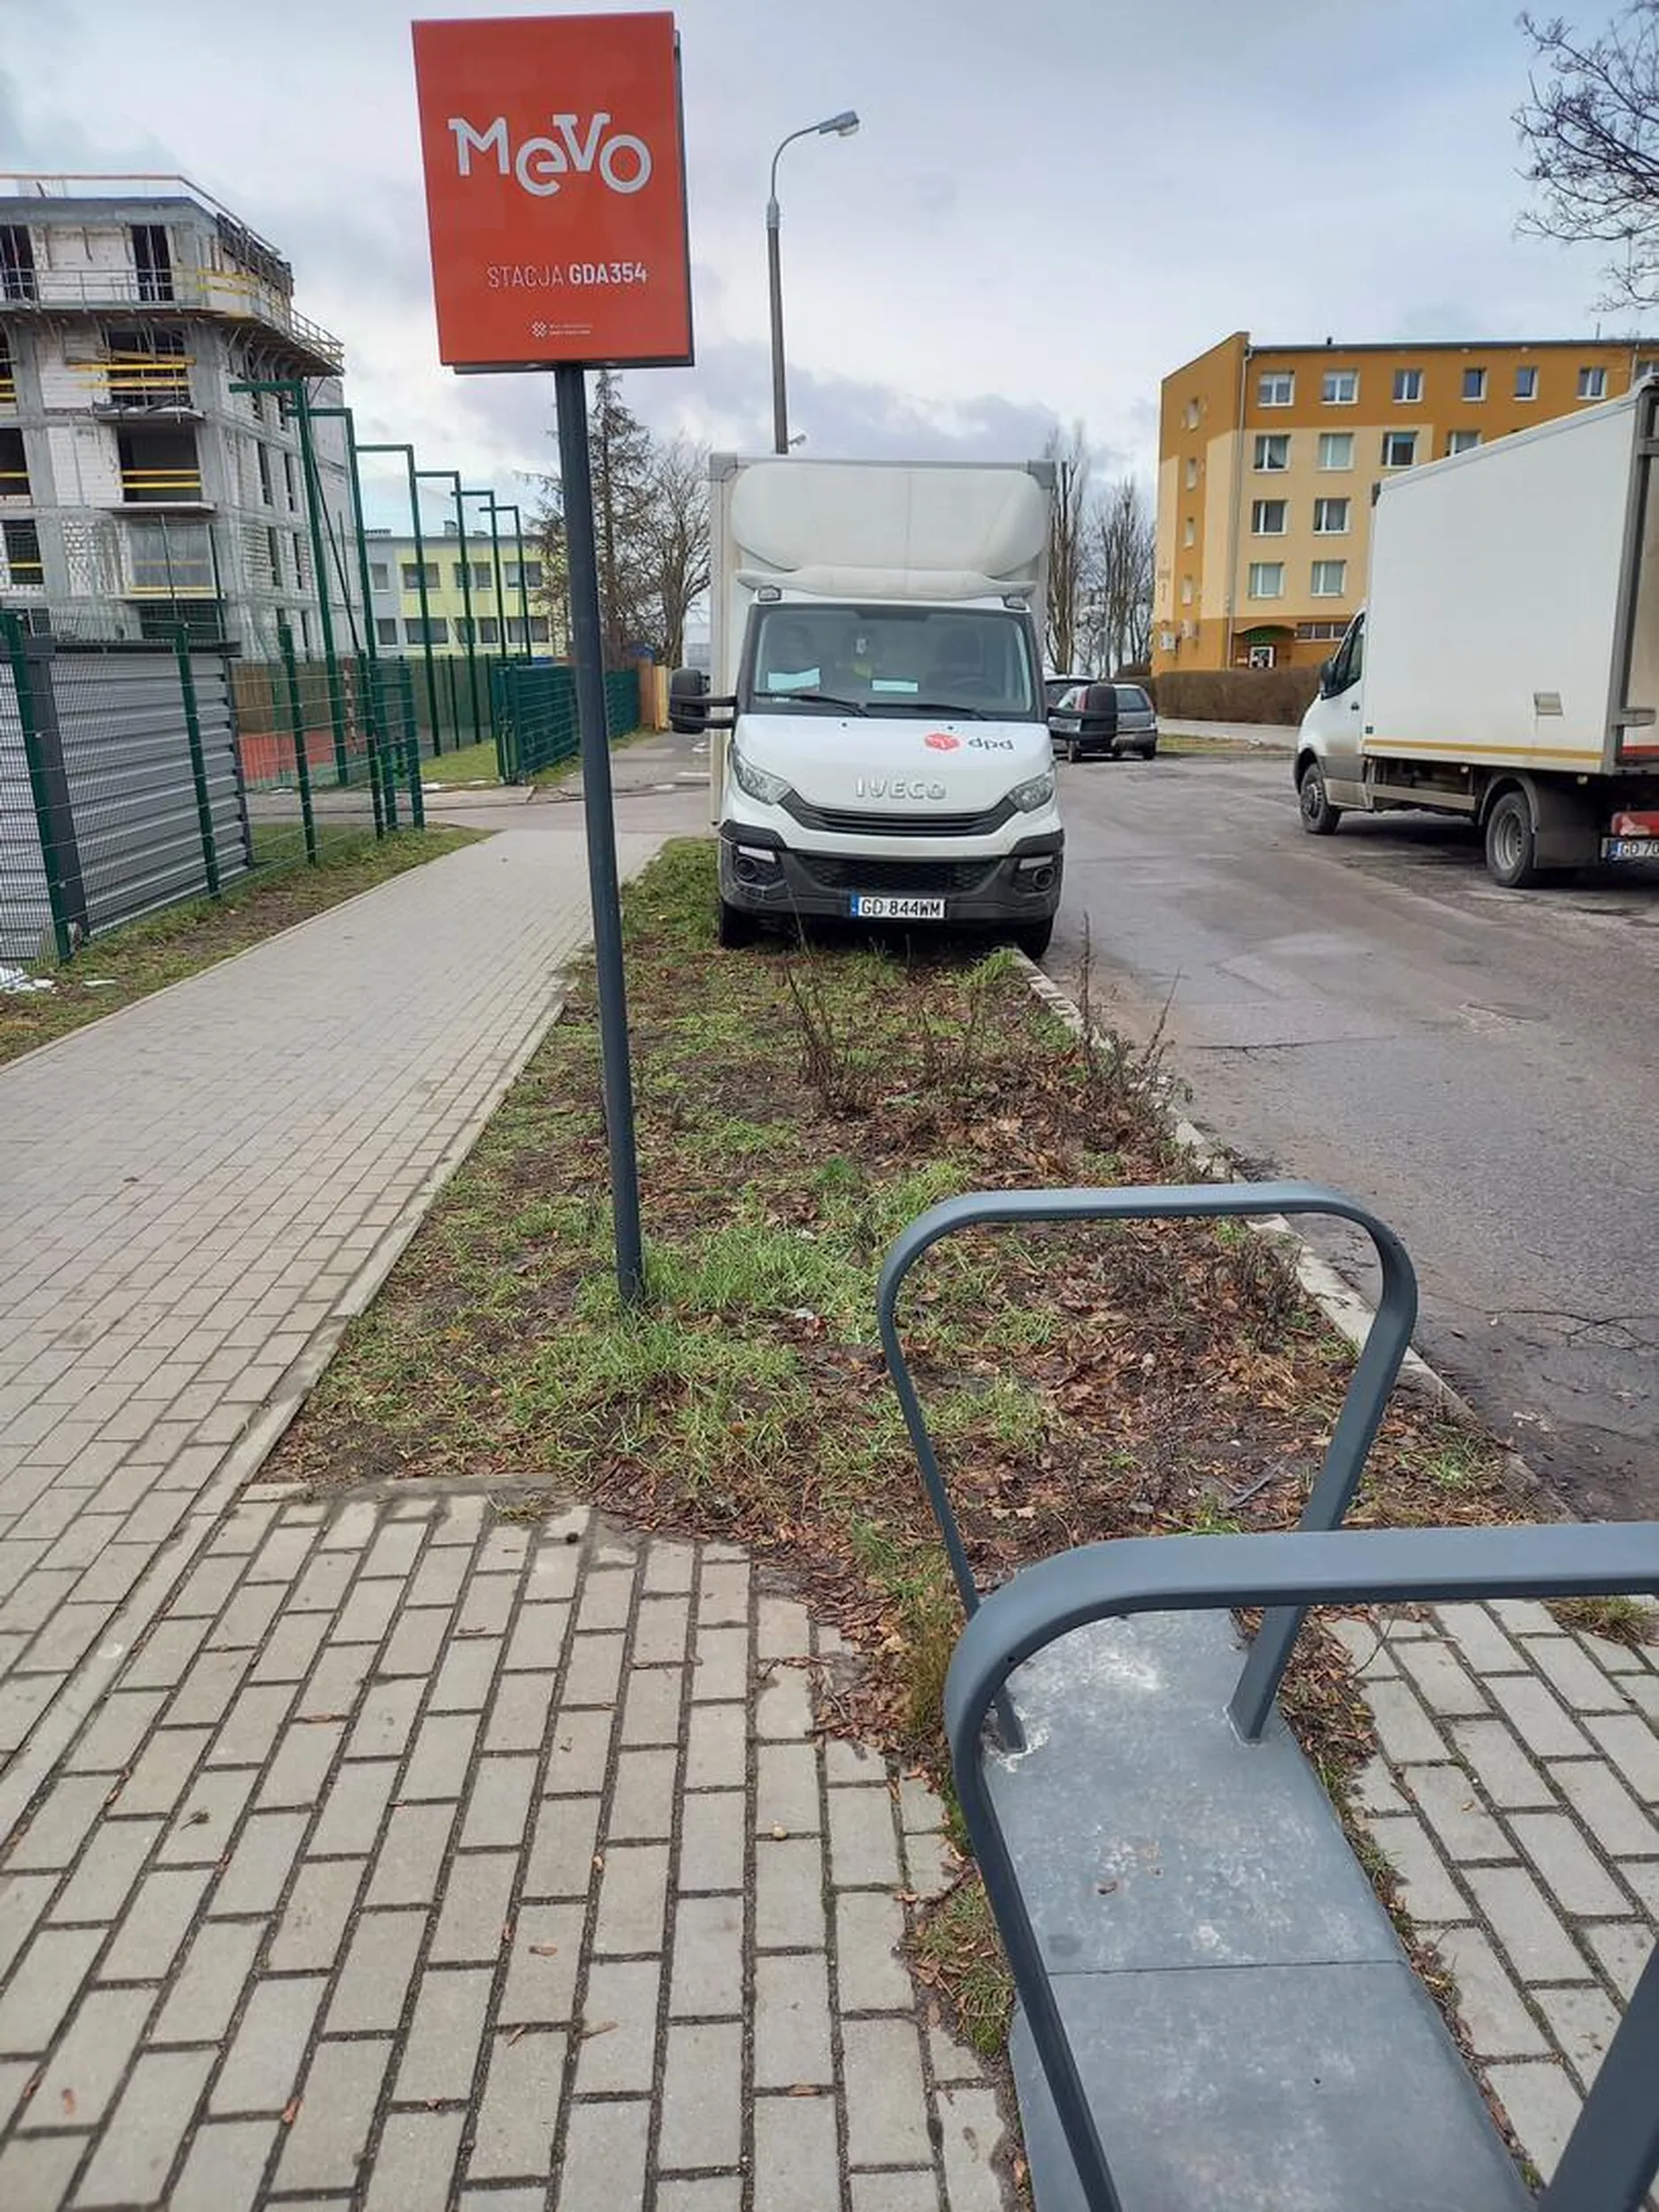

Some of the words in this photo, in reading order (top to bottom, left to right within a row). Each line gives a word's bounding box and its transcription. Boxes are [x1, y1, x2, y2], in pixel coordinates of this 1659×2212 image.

[487, 264, 564, 288] STACJA
[569, 262, 647, 284] GDA354
[967, 736, 1014, 750] dpd
[855, 775, 947, 800] IVECO
[861, 898, 884, 915] GD
